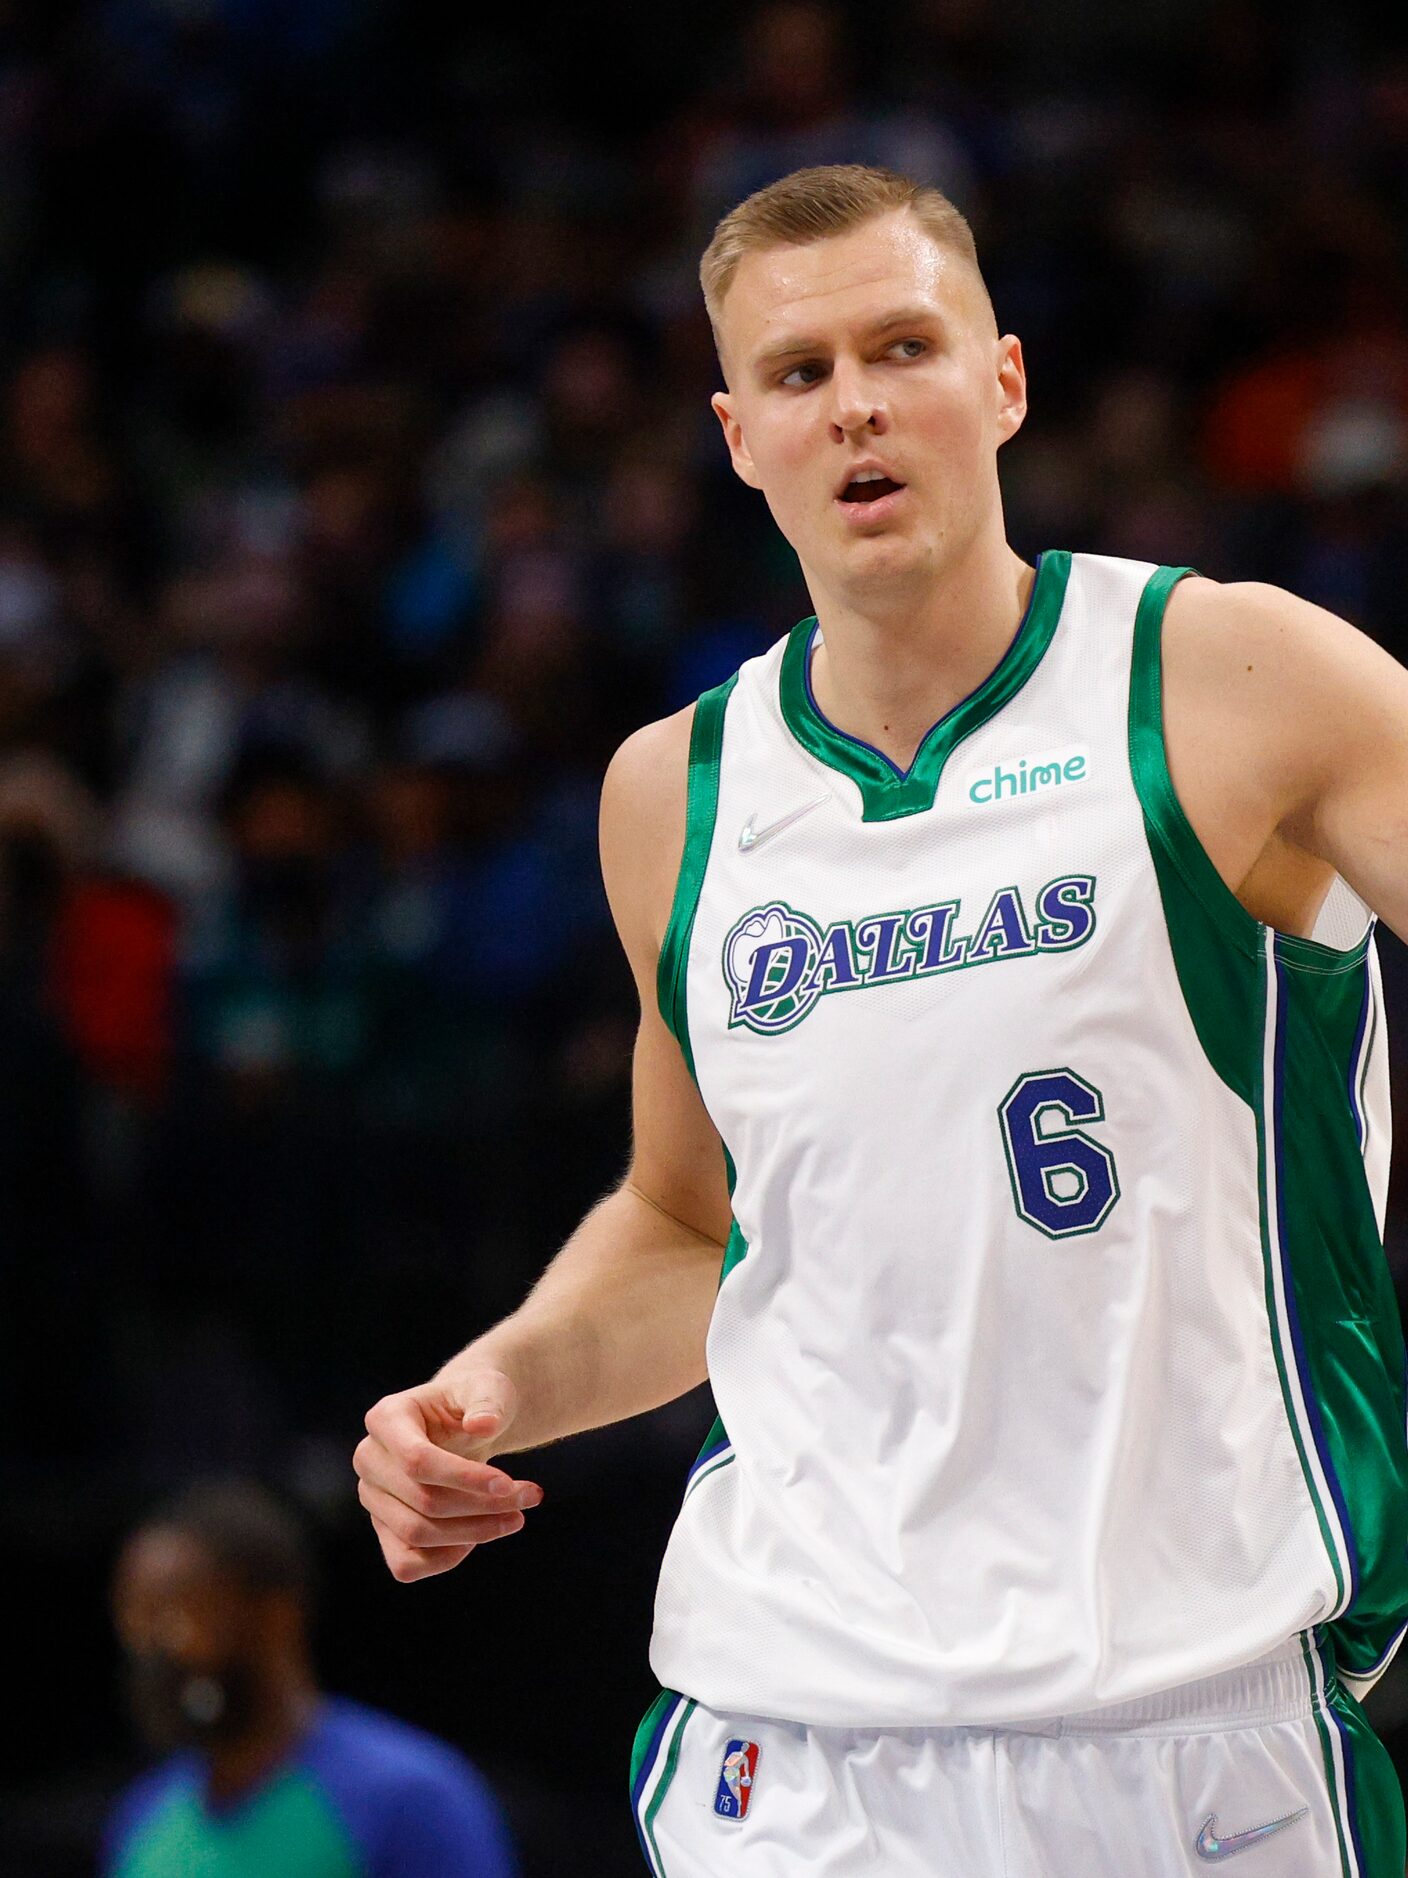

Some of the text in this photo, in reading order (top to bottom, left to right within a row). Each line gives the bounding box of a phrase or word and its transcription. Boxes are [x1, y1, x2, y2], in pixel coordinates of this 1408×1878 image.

[969, 755, 1086, 804] chime
[726, 875, 1097, 1024] DALLAS
[997, 1066, 1121, 1240] 6
[719, 1794, 732, 1812] 75
